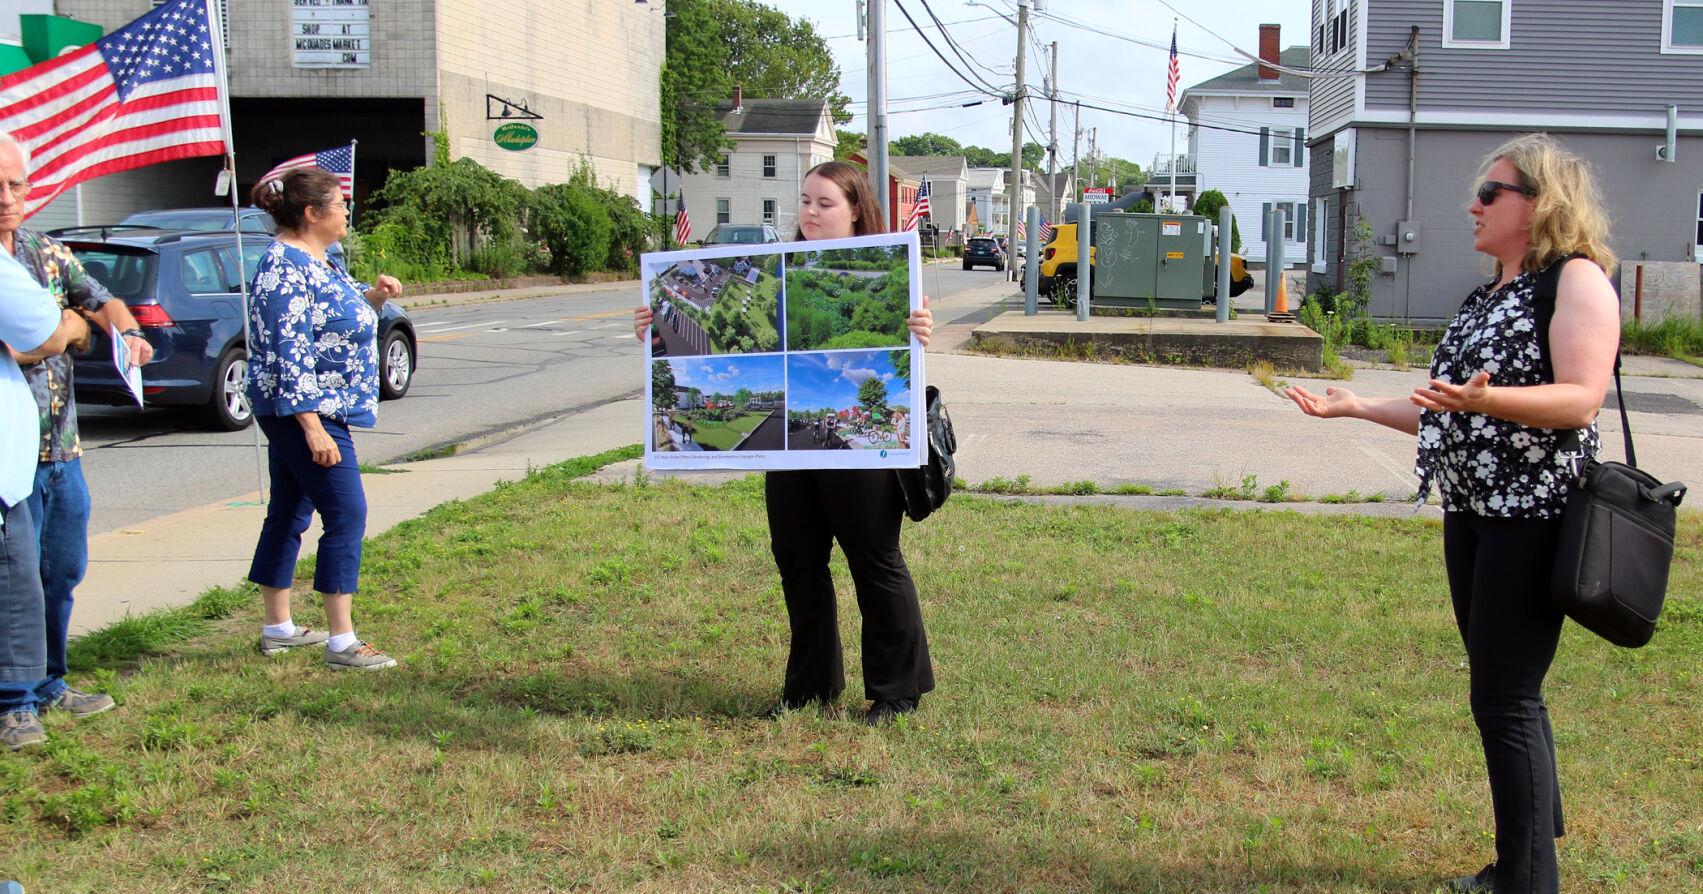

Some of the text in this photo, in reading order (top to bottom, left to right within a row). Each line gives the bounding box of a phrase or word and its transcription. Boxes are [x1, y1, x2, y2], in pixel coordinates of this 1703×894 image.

[302, 24, 351, 35] SHOP AT
[296, 38, 361, 50] MCQUADES MARKET
